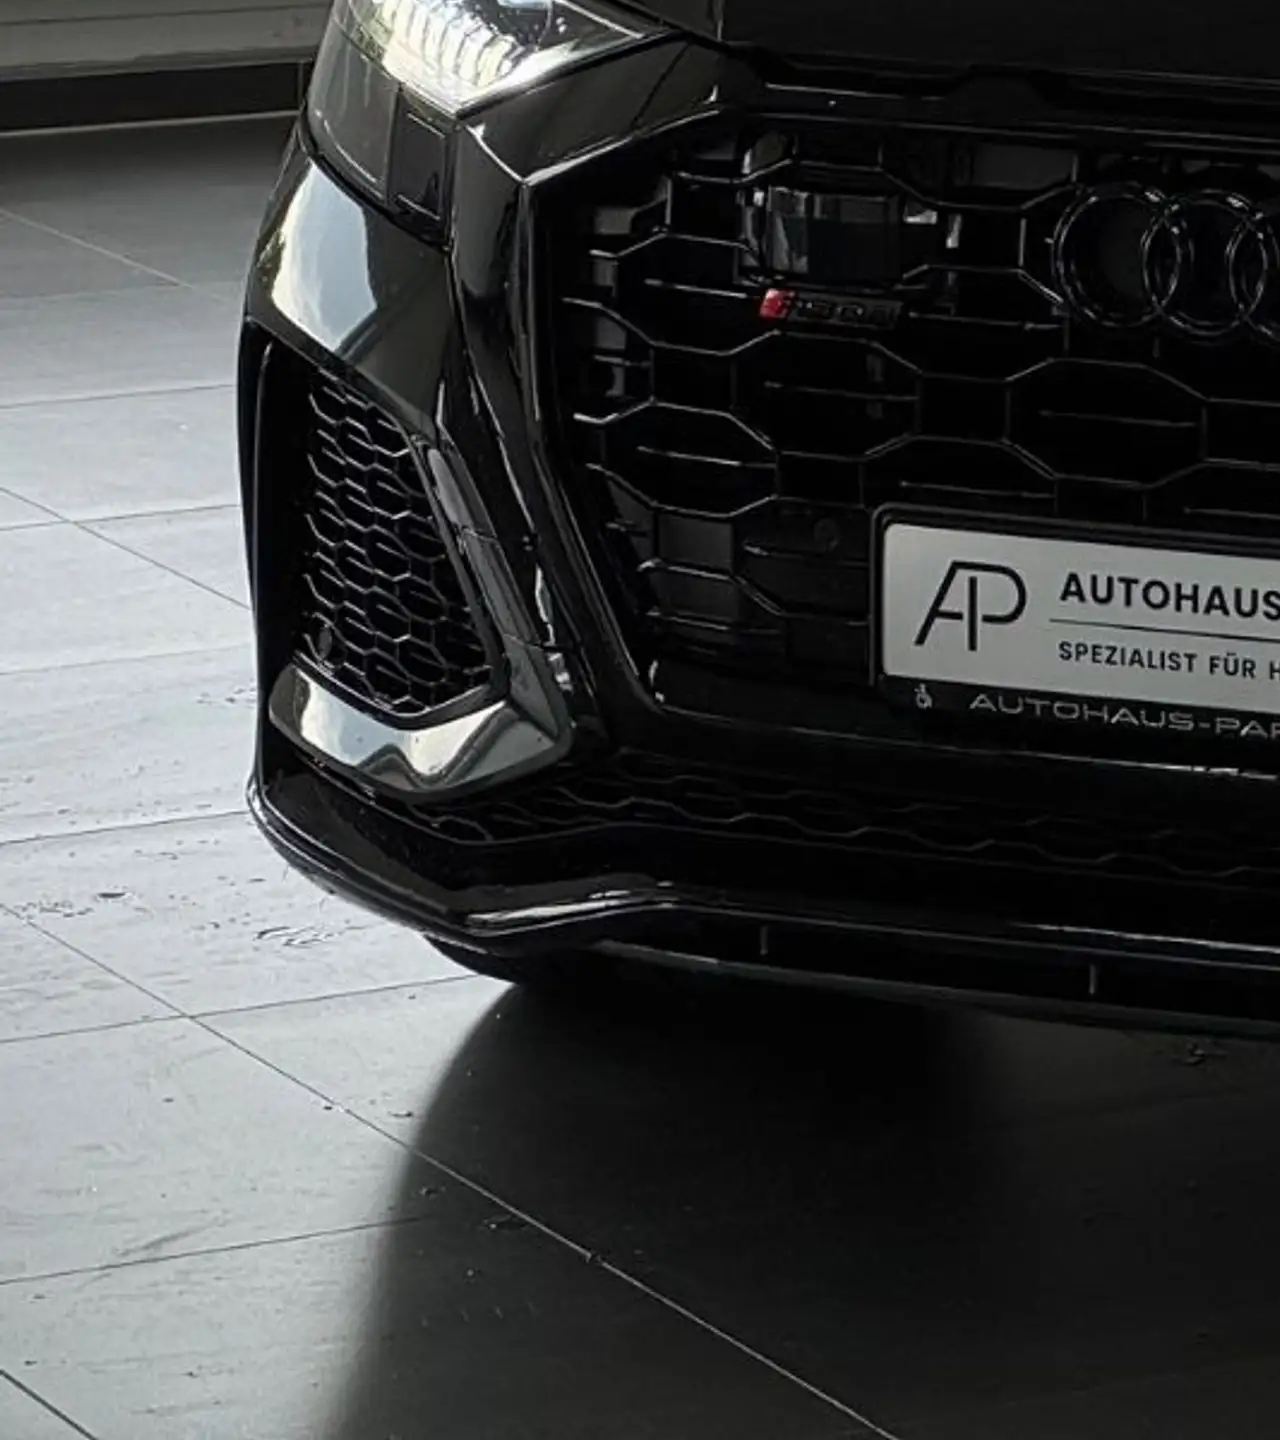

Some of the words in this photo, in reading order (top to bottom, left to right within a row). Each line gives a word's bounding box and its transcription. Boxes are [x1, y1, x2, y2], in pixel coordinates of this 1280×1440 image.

[914, 561, 1026, 650] AP
[1058, 642, 1198, 673] SPEZIALIST
[1209, 653, 1256, 680] FÜR
